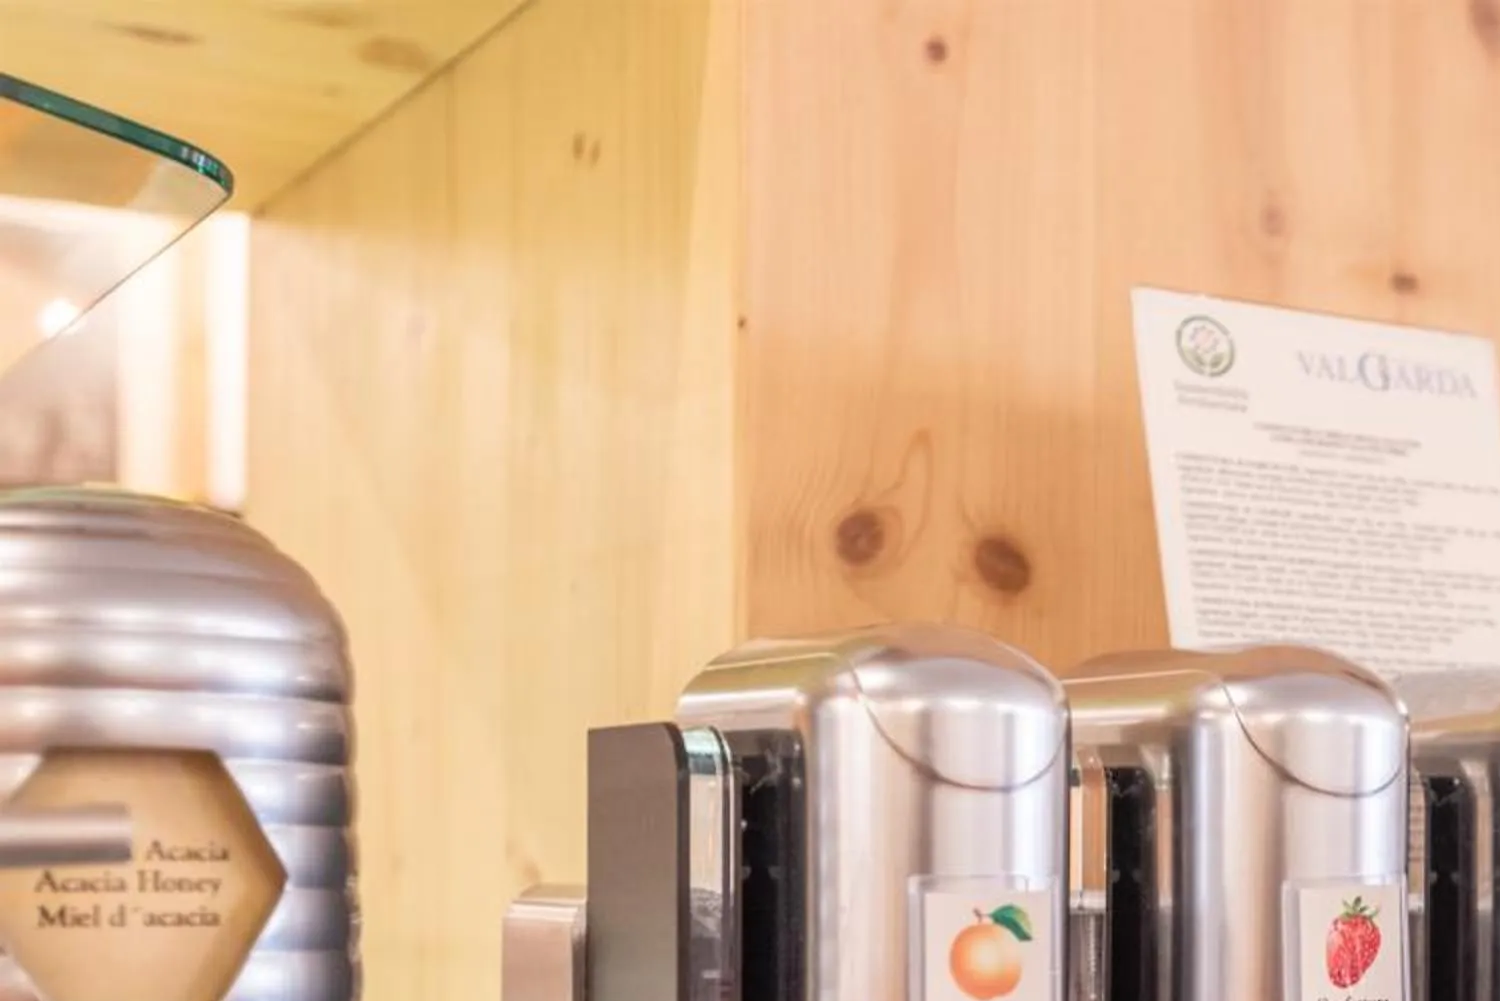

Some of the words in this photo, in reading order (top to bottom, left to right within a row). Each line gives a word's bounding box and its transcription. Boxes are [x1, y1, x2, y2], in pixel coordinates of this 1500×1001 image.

[145, 840, 230, 862] Acacia
[34, 870, 127, 893] Acacia
[136, 869, 222, 896] Honey
[36, 904, 101, 928] Miel
